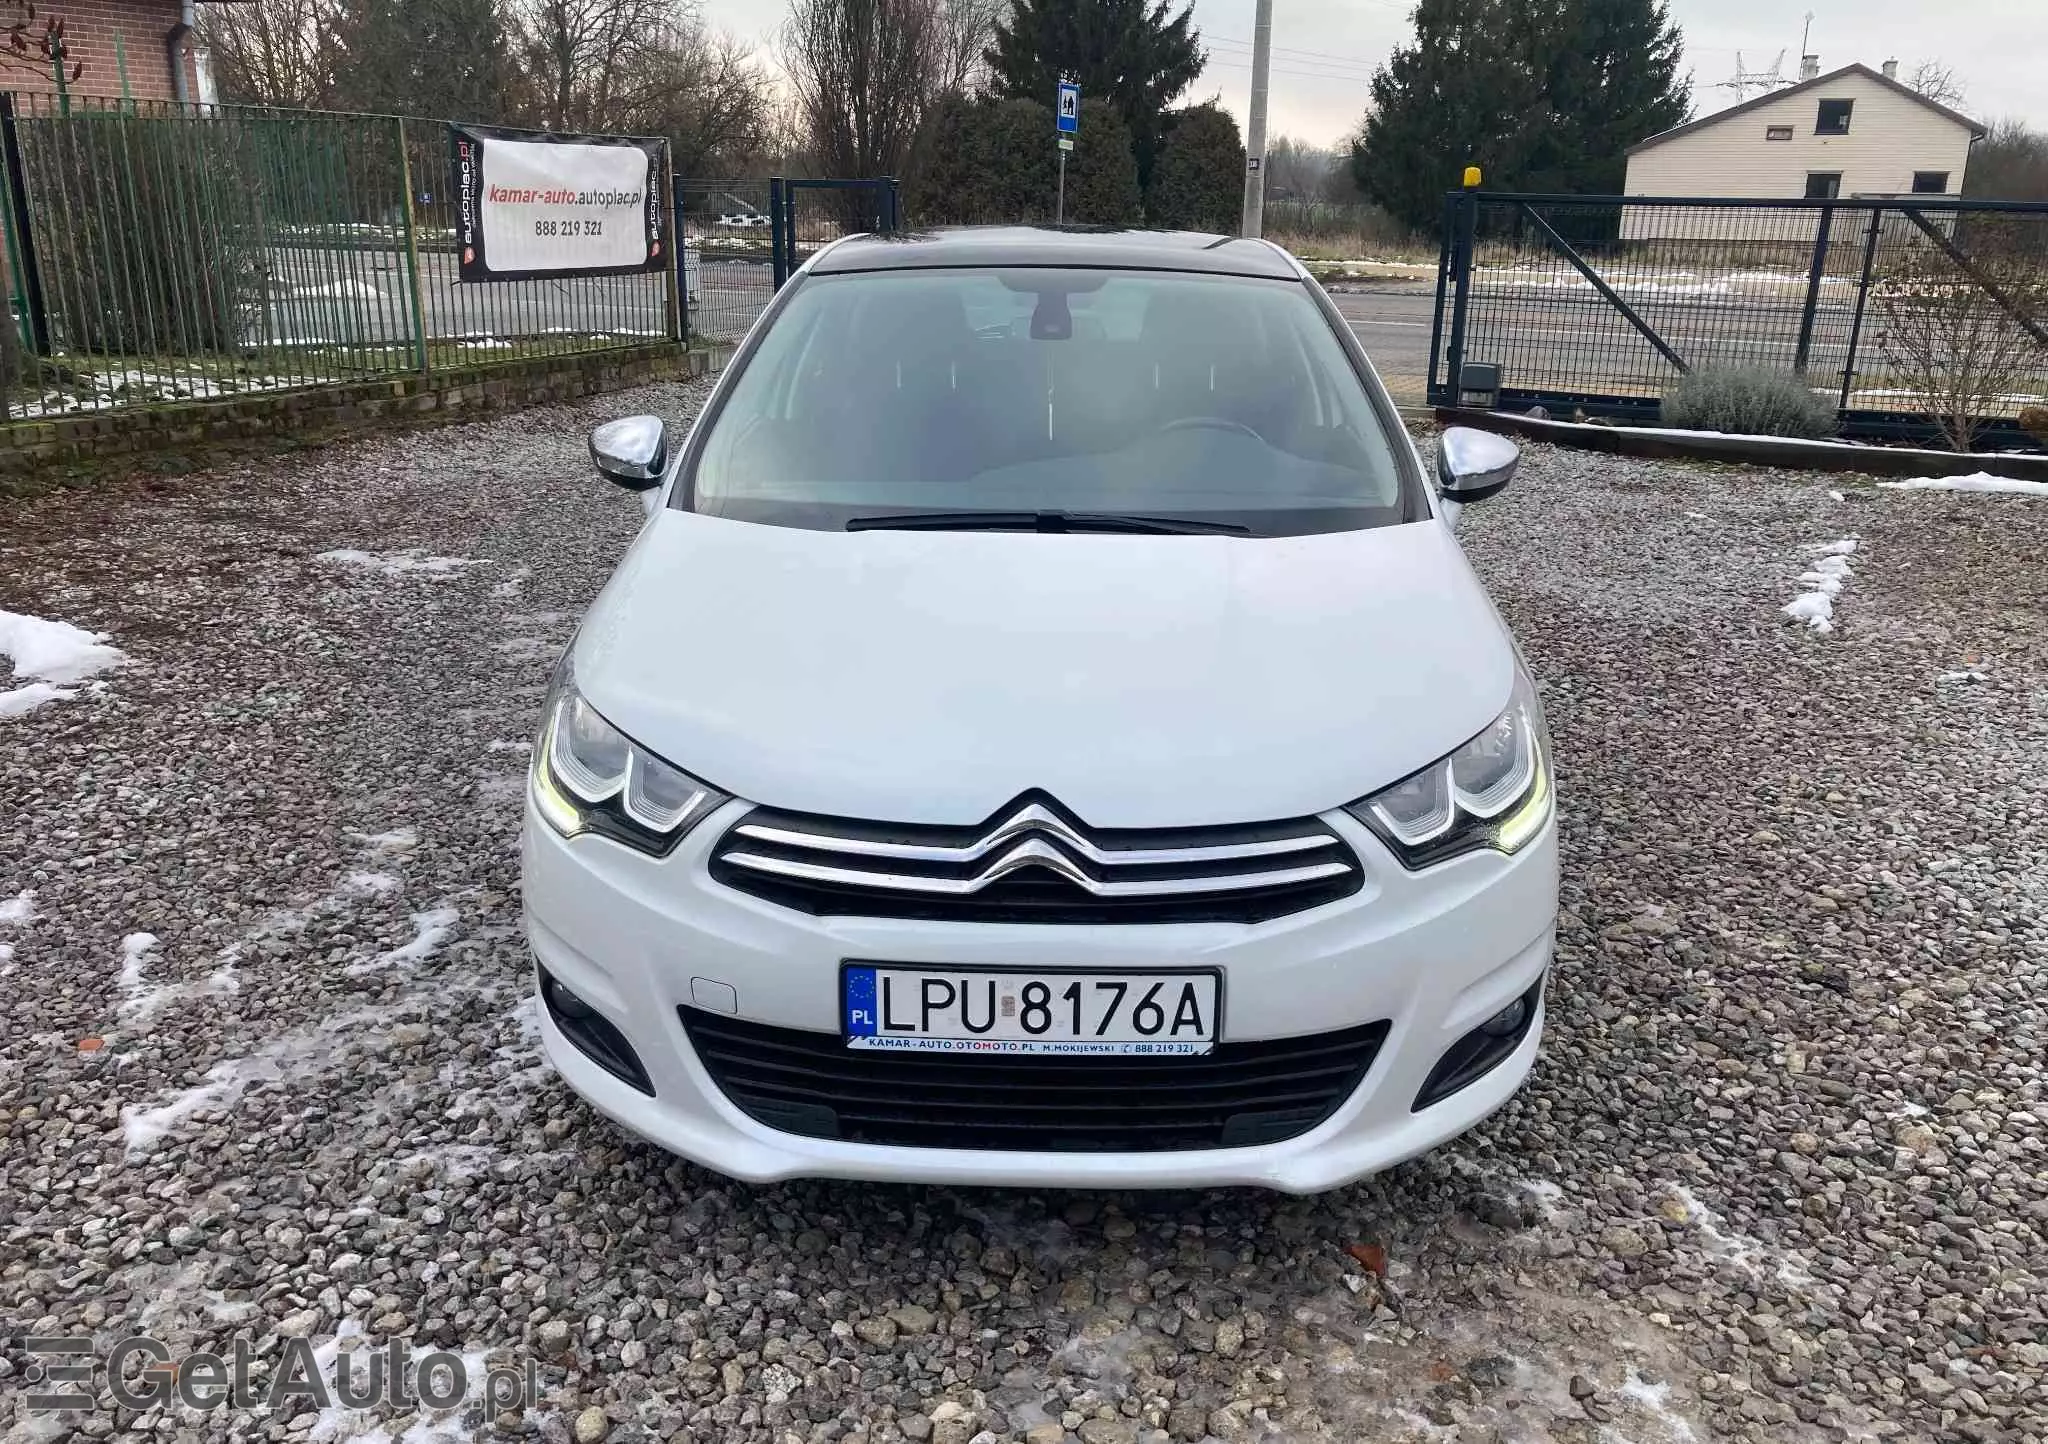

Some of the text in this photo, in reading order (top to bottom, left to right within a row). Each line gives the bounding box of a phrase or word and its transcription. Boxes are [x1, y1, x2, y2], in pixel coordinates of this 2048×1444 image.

[458, 141, 473, 244] autoplac.pl
[489, 183, 642, 209] kamar-auto.autoplac.pl
[535, 220, 602, 237] 888 219 321
[882, 976, 1204, 1036] LPU 8176A
[851, 1009, 874, 1026] PL
[1042, 1044, 1115, 1053] M.MOKIJEWSKI
[1134, 1044, 1153, 1053] 888
[1154, 1044, 1174, 1054] 219
[1177, 1044, 1194, 1054] 321
